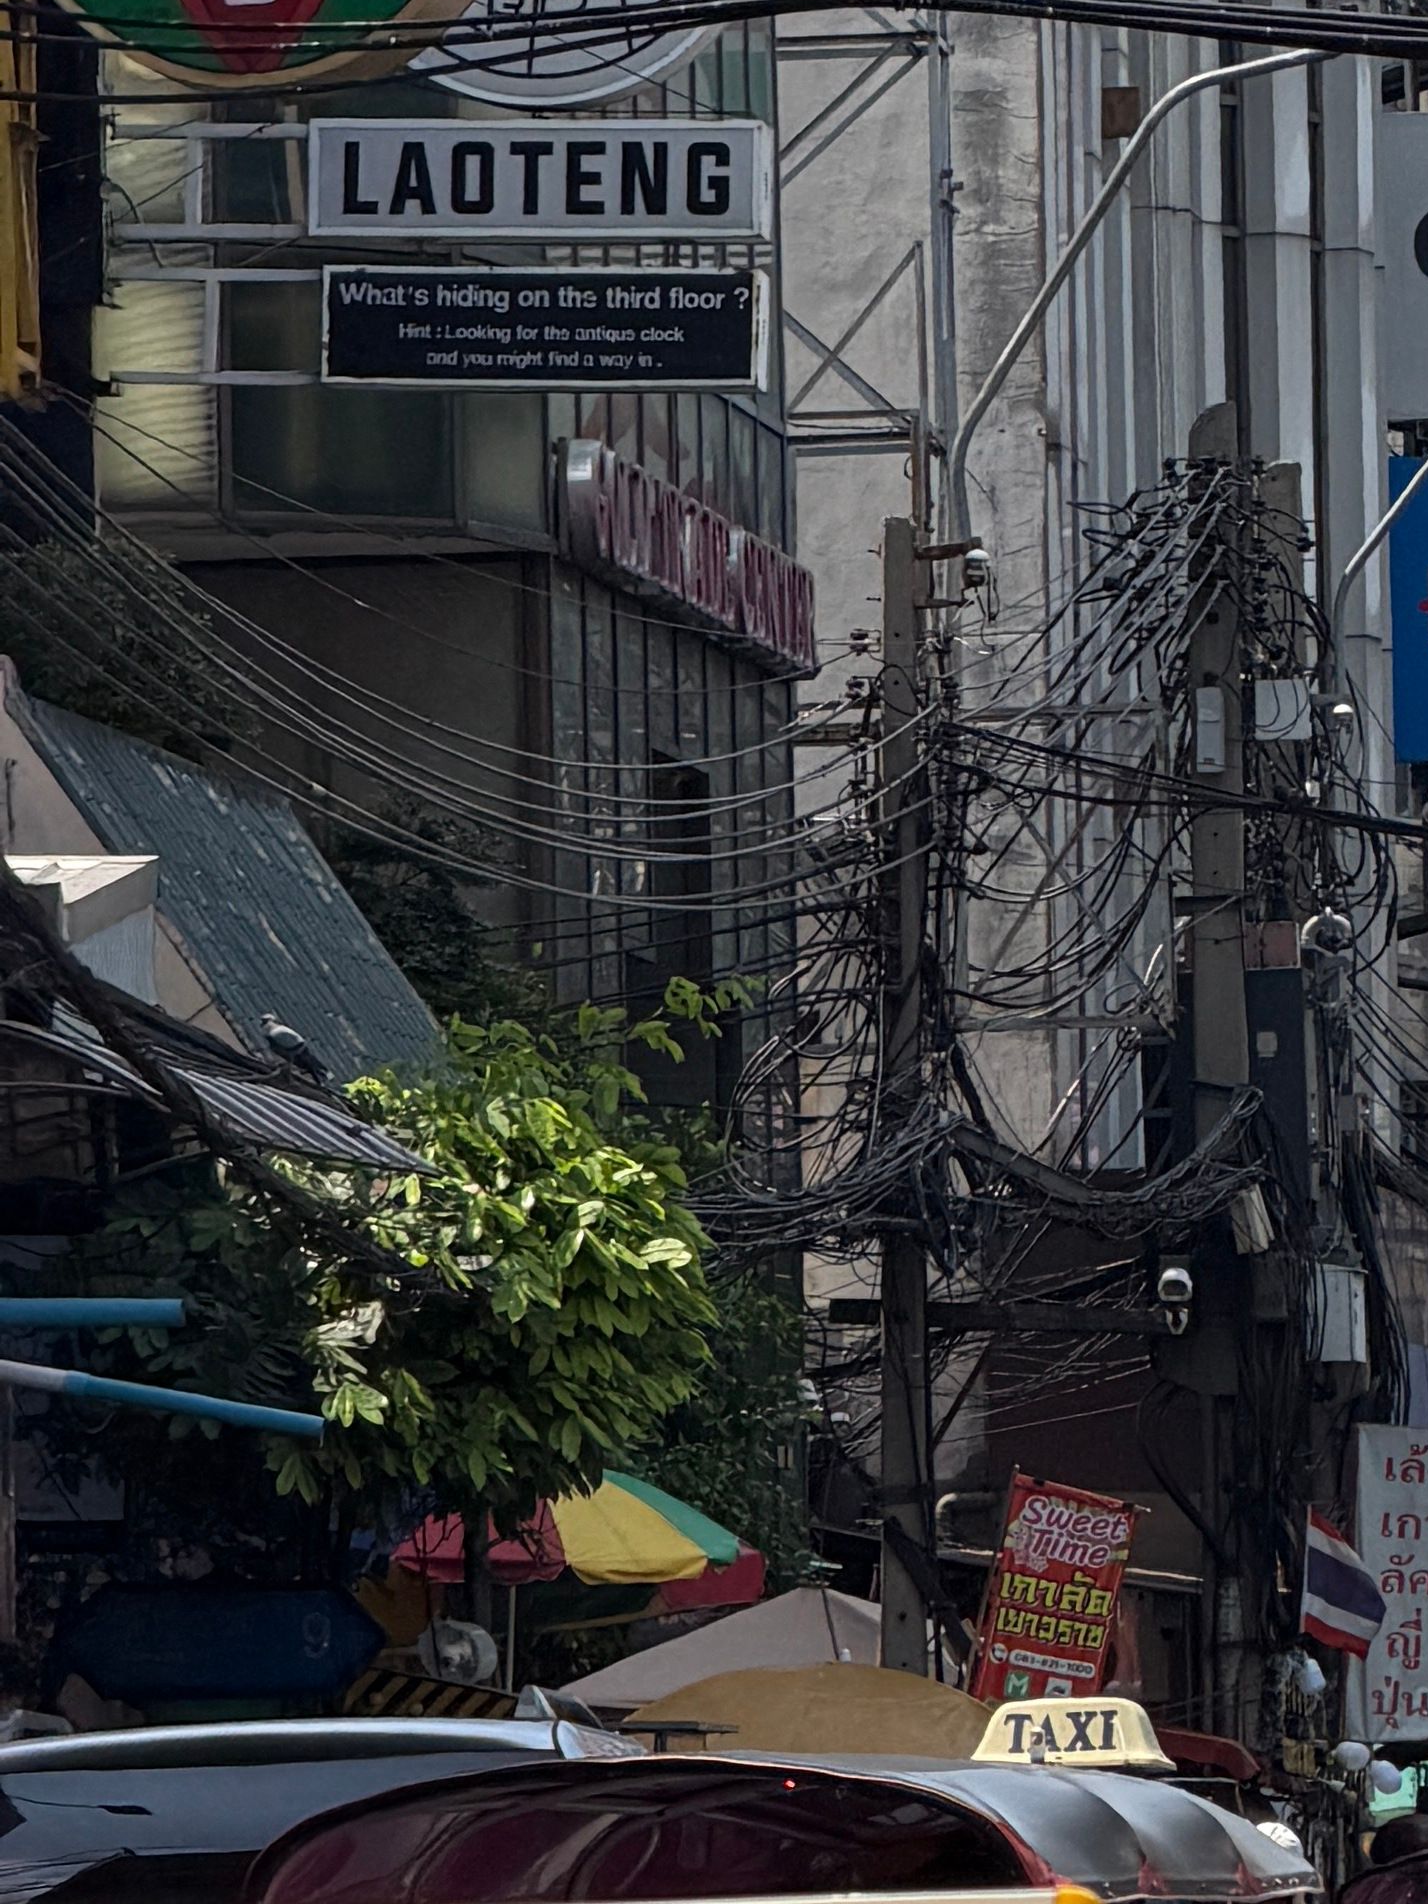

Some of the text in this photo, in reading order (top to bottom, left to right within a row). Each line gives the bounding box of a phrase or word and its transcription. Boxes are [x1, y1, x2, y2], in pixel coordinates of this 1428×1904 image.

[342, 141, 731, 215] LAOTENG
[340, 282, 428, 307] What's
[437, 287, 510, 312] hiding
[518, 291, 549, 308] on
[558, 286, 597, 308] the
[606, 287, 660, 309] third
[669, 287, 725, 310] floor
[399, 323, 432, 339] Hint
[445, 325, 511, 343] Looking
[516, 324, 538, 340] for
[544, 325, 570, 341] the
[576, 326, 635, 344] antique
[641, 326, 685, 342] clock
[427, 350, 457, 367] and
[463, 353, 493, 369] you
[498, 350, 542, 369] might
[549, 350, 578, 367] find
[584, 354, 593, 367] a
[600, 353, 632, 370] way
[1022, 1496, 1128, 1542] Sweet
[1032, 1528, 1111, 1567] Time
[1001, 1571, 1112, 1617] เกาลัด
[998, 1607, 1106, 1649] เยาวราช
[1004, 1709, 1118, 1753] TAXI
